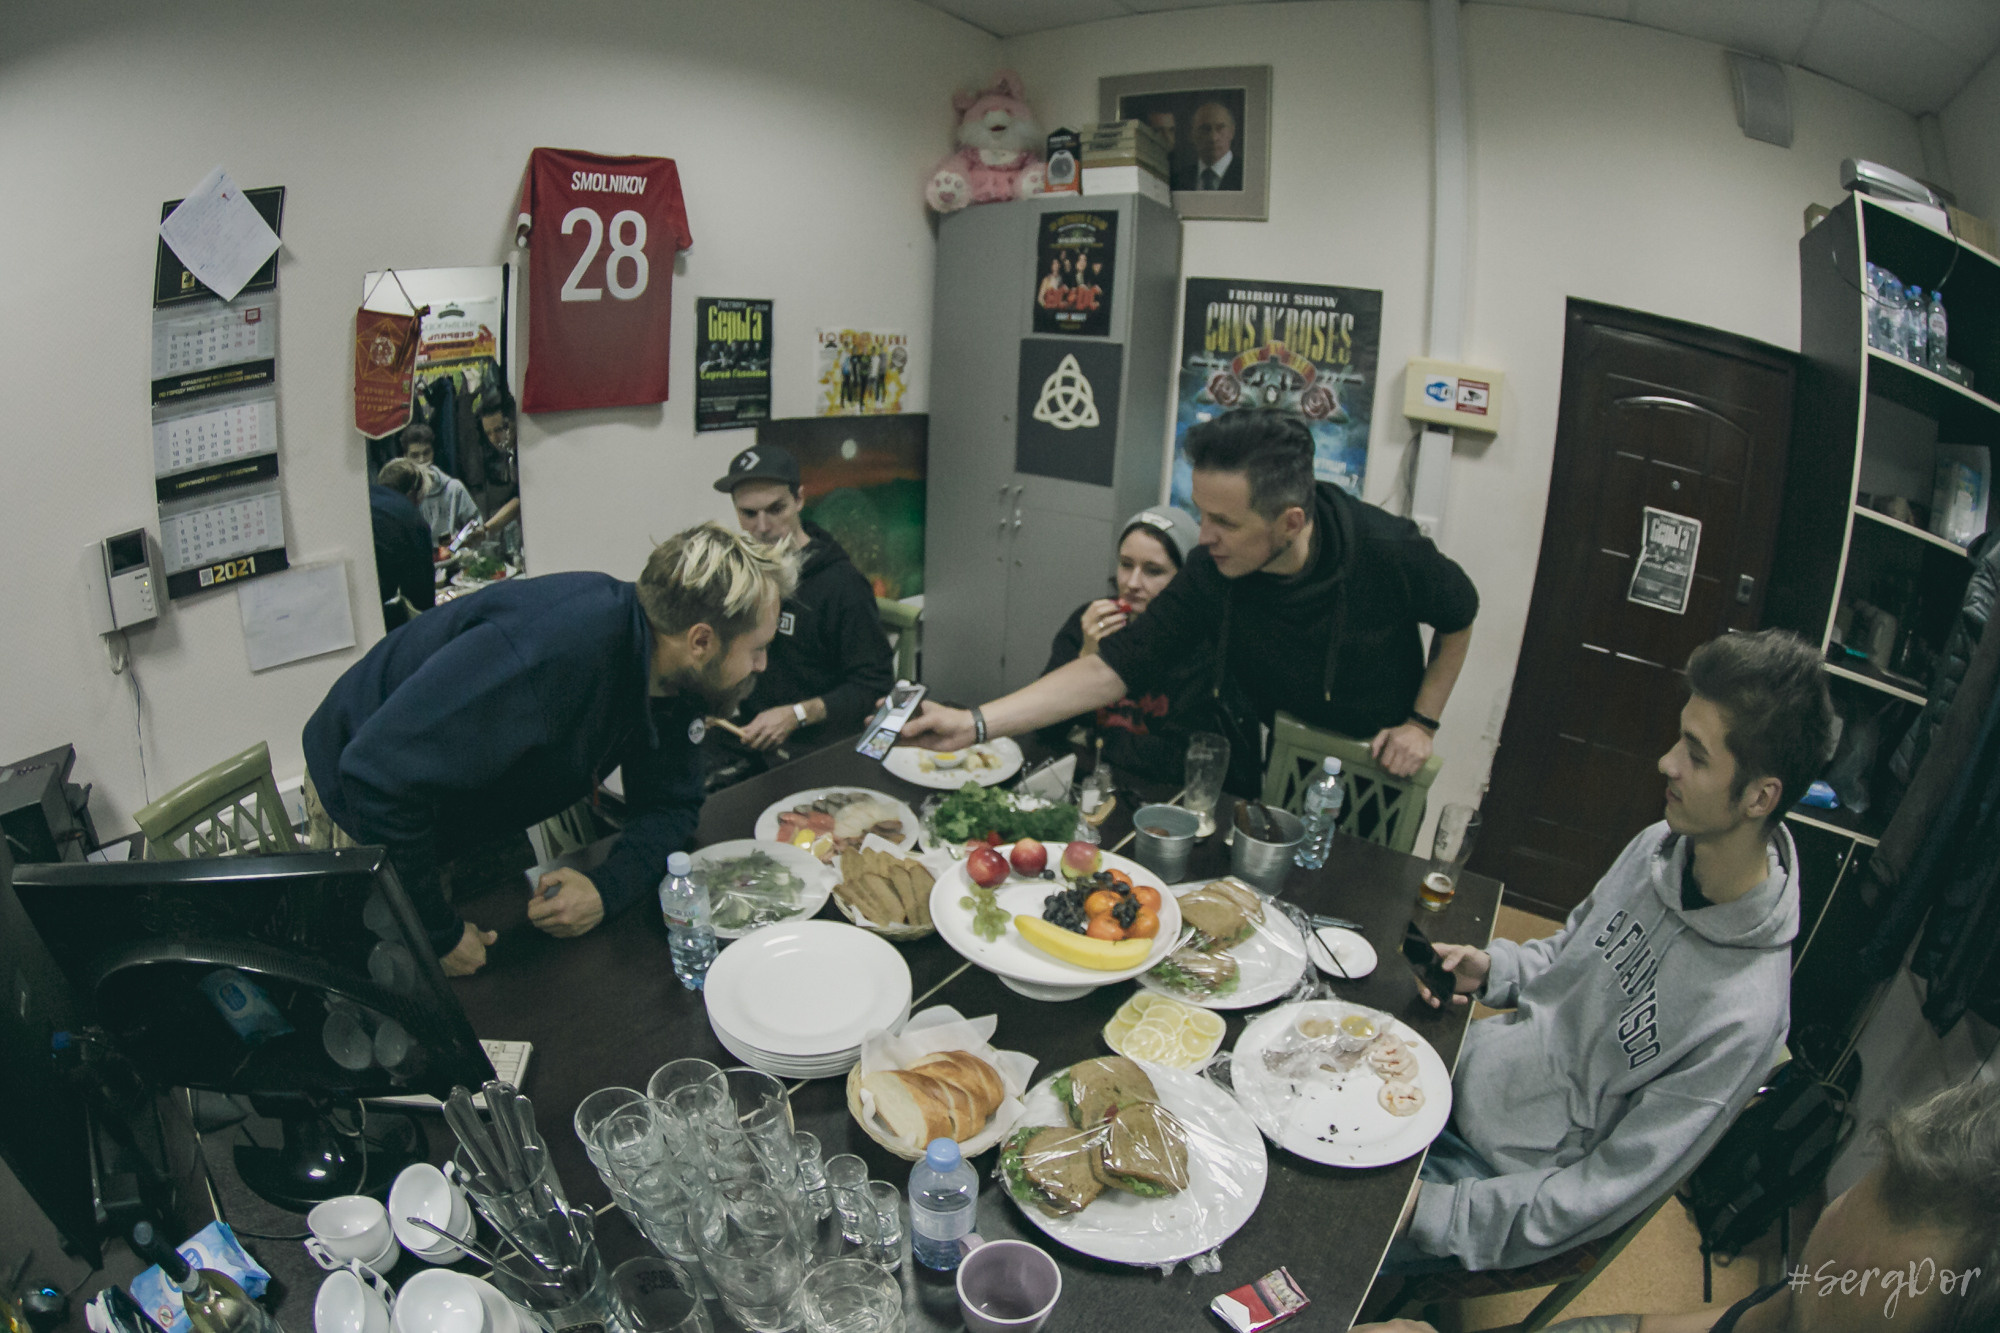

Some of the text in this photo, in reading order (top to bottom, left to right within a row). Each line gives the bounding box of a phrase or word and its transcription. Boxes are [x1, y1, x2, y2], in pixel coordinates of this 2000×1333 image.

[571, 171, 648, 195] SMOLNIKOV
[560, 207, 649, 302] 28
[1293, 294, 1339, 308] SHOW
[1205, 302, 1257, 353] GUNS
[213, 556, 256, 583] 2021
